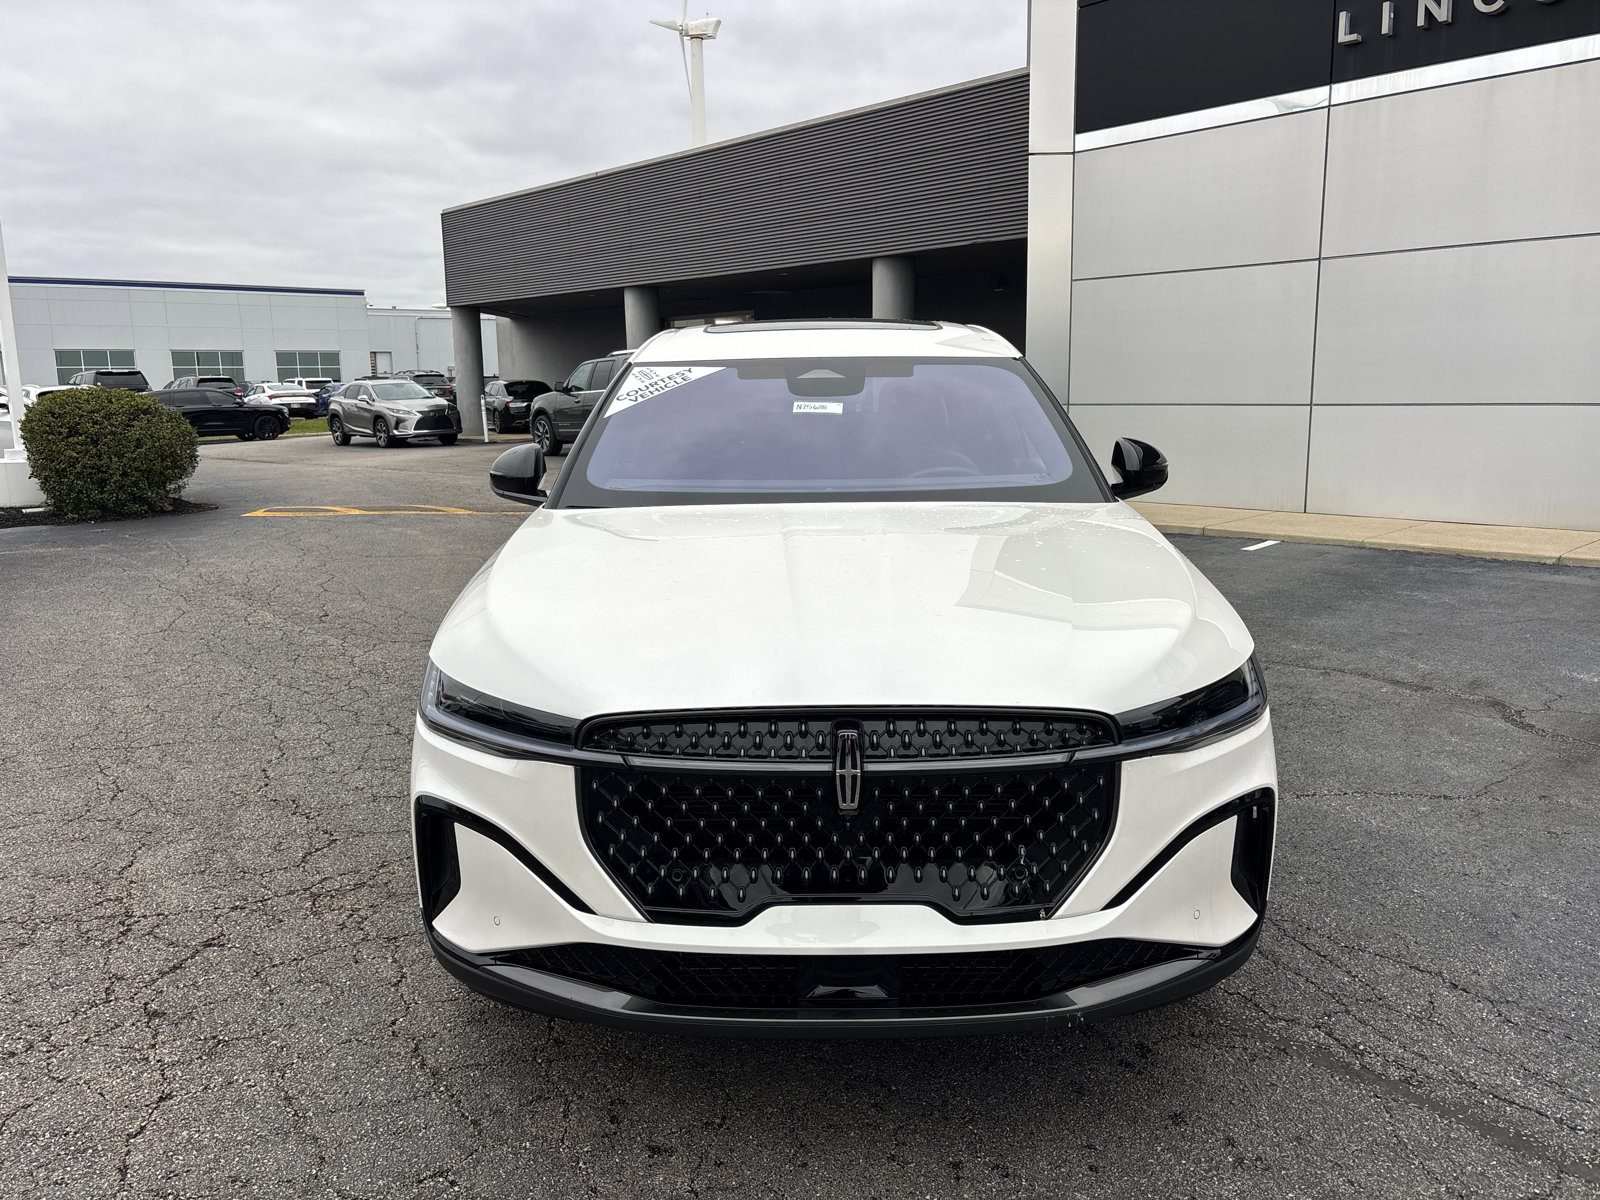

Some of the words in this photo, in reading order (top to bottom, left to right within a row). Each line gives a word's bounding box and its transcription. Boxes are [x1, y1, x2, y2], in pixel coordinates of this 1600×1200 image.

[1338, 0, 1560, 44] LIN
[616, 368, 693, 401] COURTESY
[628, 375, 692, 402] VEHICLE
